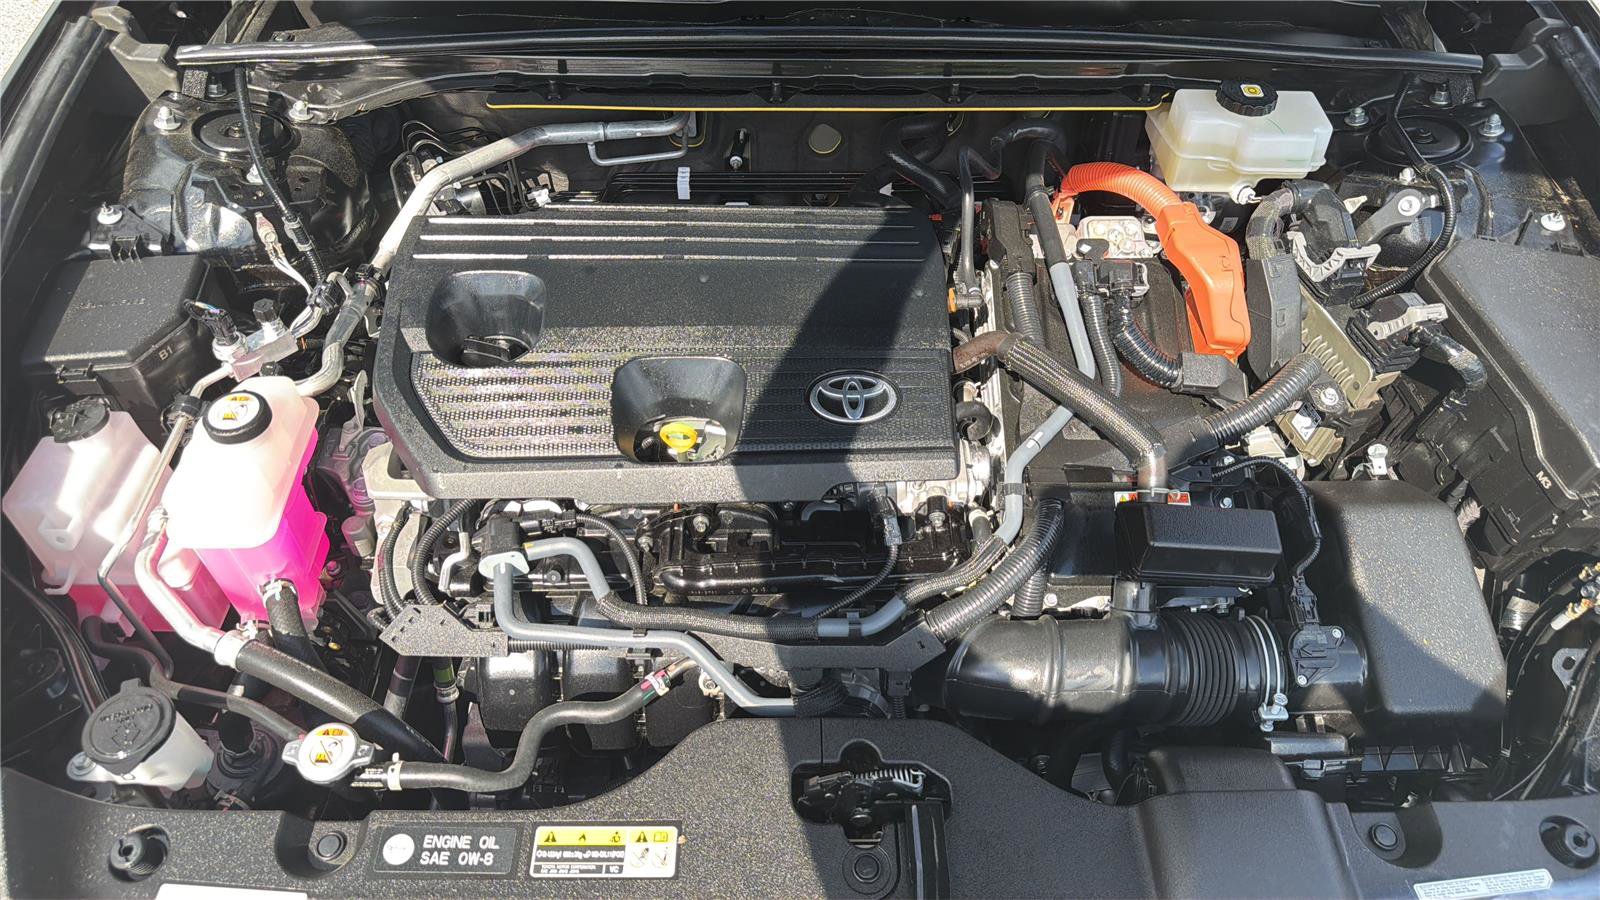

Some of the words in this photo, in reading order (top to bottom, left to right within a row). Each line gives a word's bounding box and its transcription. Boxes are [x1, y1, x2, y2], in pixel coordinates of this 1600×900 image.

[159, 346, 173, 360] B1
[423, 835, 472, 849] ENGINE
[479, 836, 500, 849] OIL
[420, 851, 450, 865] SAE
